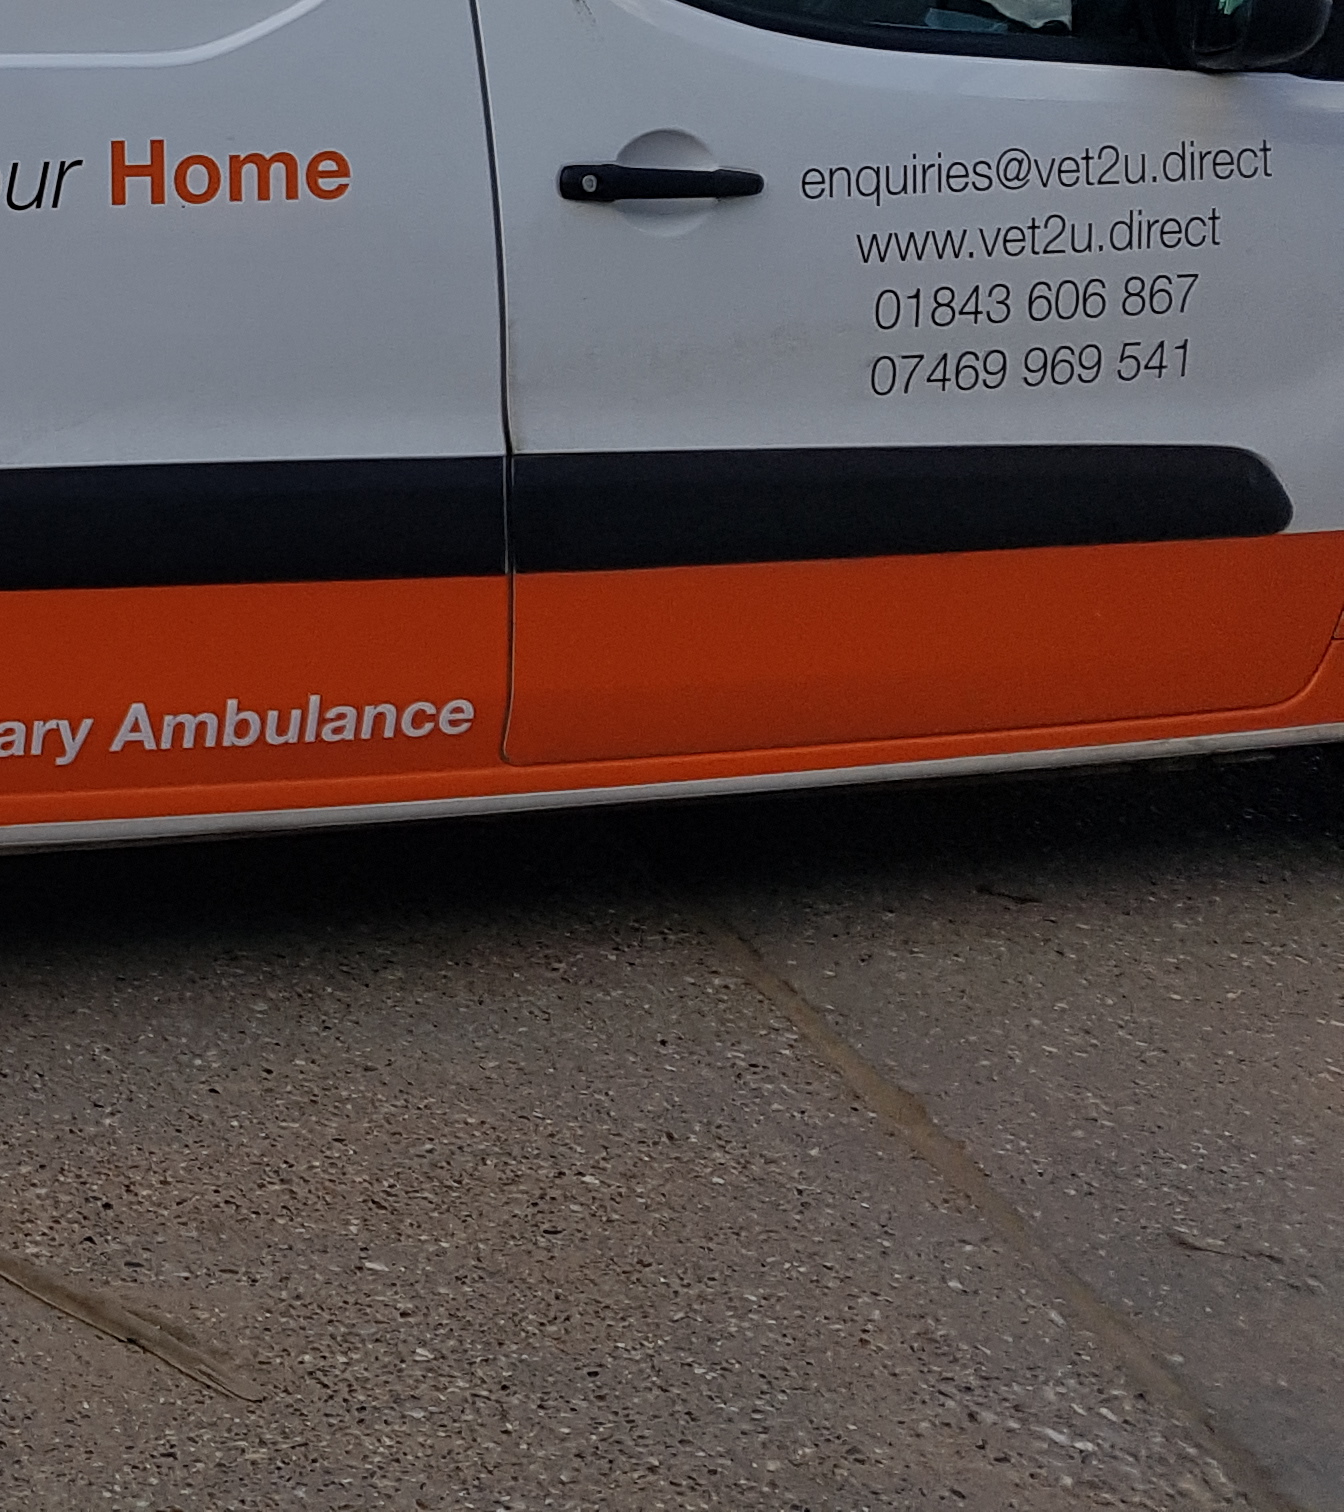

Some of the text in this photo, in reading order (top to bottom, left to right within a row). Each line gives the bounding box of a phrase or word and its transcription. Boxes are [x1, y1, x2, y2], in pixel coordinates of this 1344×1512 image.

[110, 139, 351, 205] Home
[800, 138, 1273, 206] enquiries@vet2u.direct
[856, 207, 1221, 264] www.vet2u.direct
[875, 274, 1200, 330] 01843 606 867
[870, 339, 1189, 396] 07469 969 541
[109, 694, 475, 752] Ambulance
